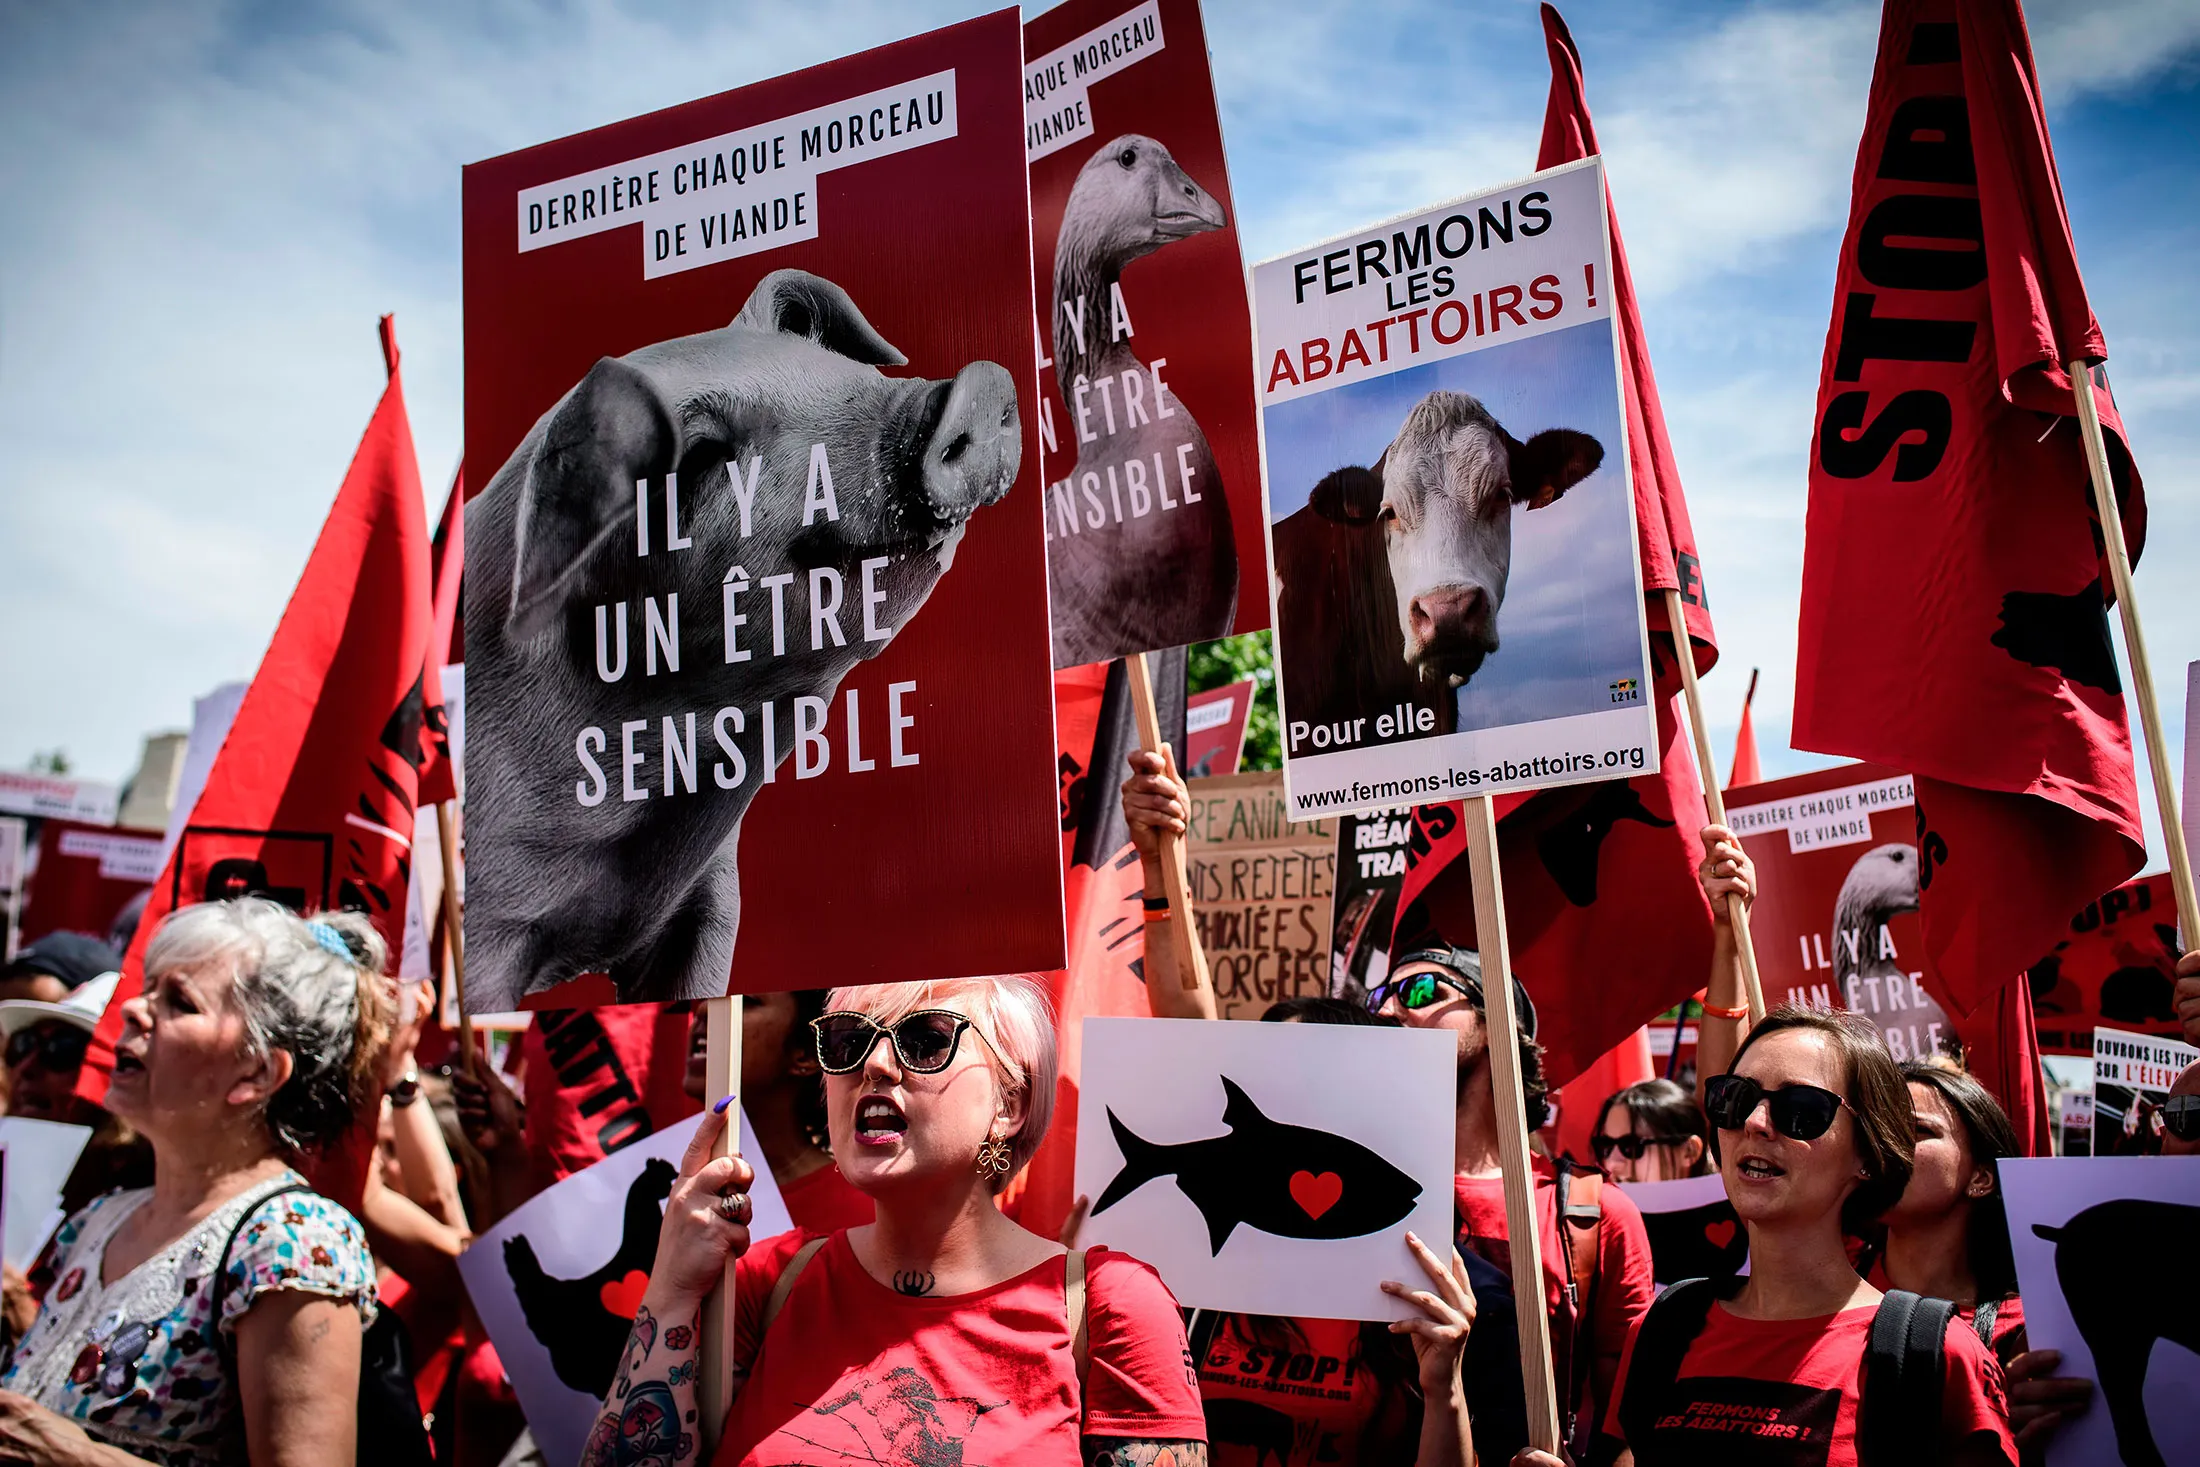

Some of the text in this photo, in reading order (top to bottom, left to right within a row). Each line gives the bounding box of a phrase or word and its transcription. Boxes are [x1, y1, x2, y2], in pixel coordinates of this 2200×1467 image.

[1025, 15, 1155, 103] AQUE MORCEAU
[527, 90, 945, 235] DERRIÈRE CHAQUE MORCEAU
[654, 192, 808, 262] DE VIANDE
[1293, 191, 1553, 304] FERMONS
[1386, 266, 1456, 312] LES
[1063, 295, 1086, 355] Y
[1110, 282, 1135, 343] A
[1267, 263, 1597, 393] ABATTOIRS !
[1072, 357, 1175, 444] ÊTRE
[636, 443, 840, 556] IL Y A
[1047, 442, 1202, 541] NSIBLE
[595, 556, 892, 683] UN ÊTRE
[1611, 690, 1637, 703] L214
[575, 680, 920, 808] SENSIBLE
[1290, 702, 1436, 752] Pour elle
[1297, 746, 1645, 810] www.fermons-les-abattoirs.org
[1732, 783, 1914, 831] DERRIÈRE CHAQUE MORCEA
[1795, 820, 1865, 845] DE VIANDE
[1357, 850, 1405, 878] TRA
[1800, 924, 1898, 971] IL Y A
[1846, 972, 1928, 1015] ÊTRE
[2096, 1061, 2180, 1088] SUR L'ÉLEV
[2097, 1039, 2150, 1061] OUVRONS
[2154, 1048, 2171, 1065] LES
[1239, 1350, 1339, 1384] STOP
[1654, 1415, 1686, 1430] LES
[1684, 1417, 1799, 1439] ABATTOIRS
[1685, 1401, 1781, 1421] FERMONS
